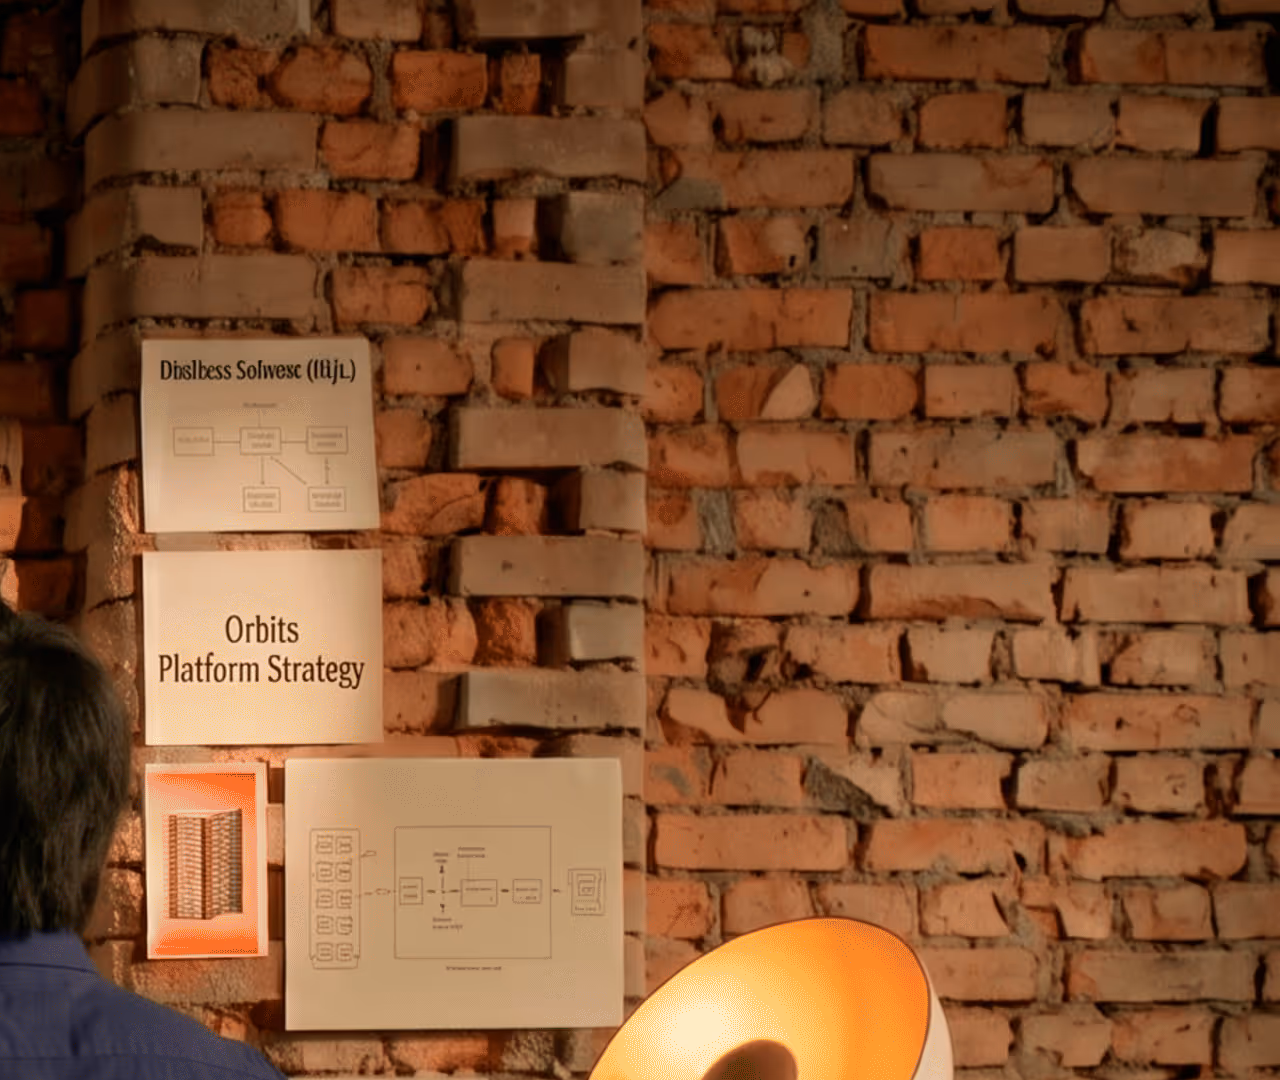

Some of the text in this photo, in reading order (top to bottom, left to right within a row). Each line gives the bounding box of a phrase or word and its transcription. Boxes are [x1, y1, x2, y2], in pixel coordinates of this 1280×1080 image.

[225, 614, 299, 644] Orbits
[158, 651, 366, 690] Platform Strategy
